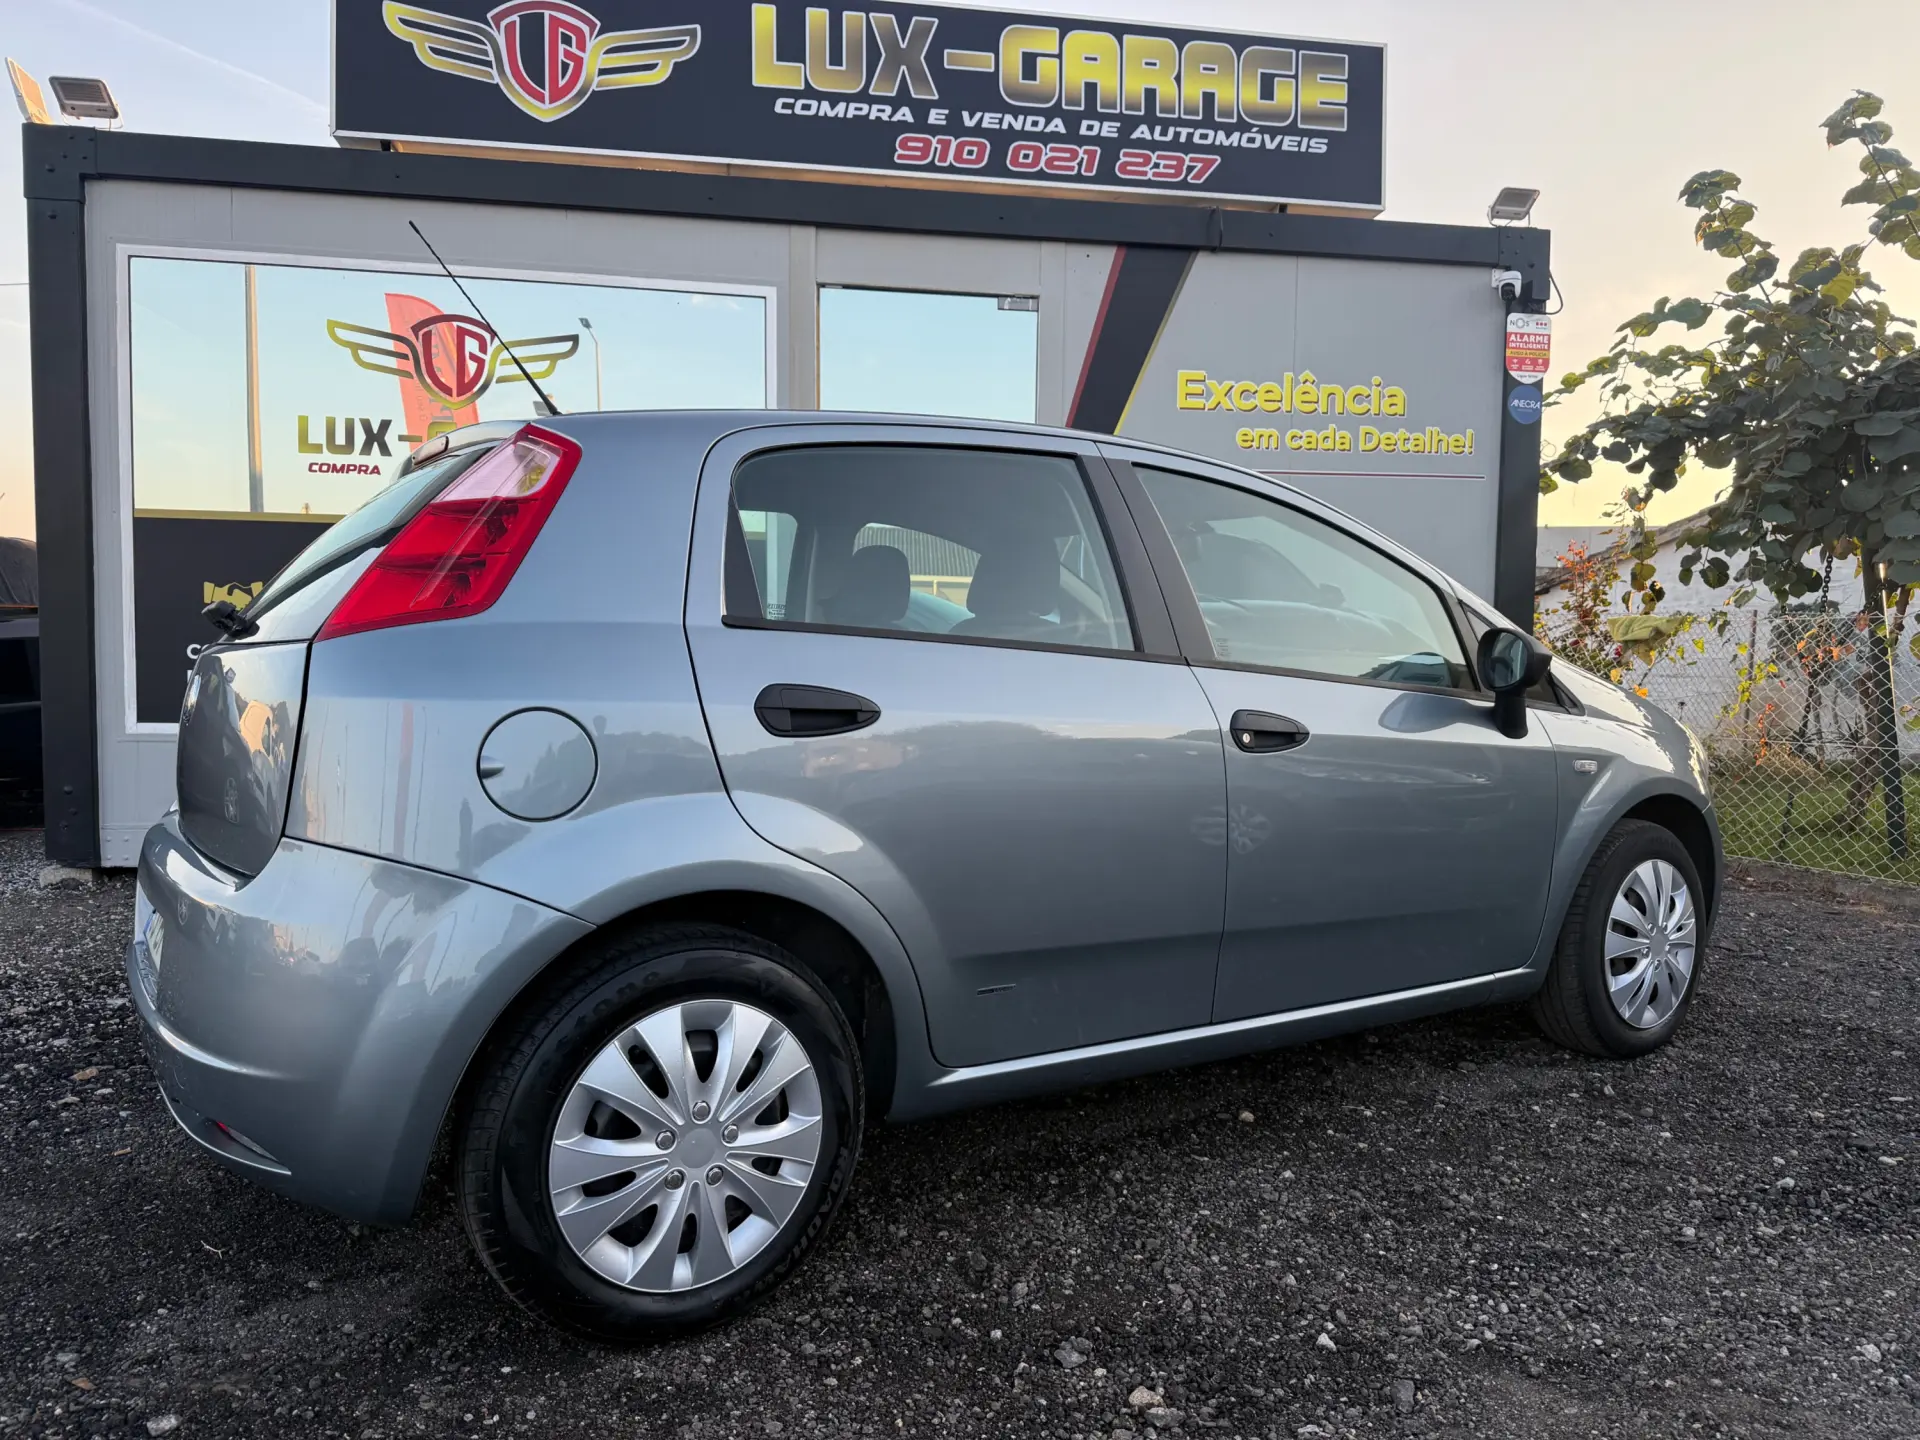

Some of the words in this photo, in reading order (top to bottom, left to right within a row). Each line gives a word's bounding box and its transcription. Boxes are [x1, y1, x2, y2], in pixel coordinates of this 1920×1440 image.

[752, 3, 1348, 131] LUX-GARAGE
[774, 98, 915, 123] COMPRA
[927, 108, 950, 126] E
[962, 111, 1067, 134] VENDA
[1079, 119, 1121, 138] DE
[1130, 124, 1328, 154] AUTOMÓVEIS
[894, 133, 990, 168] 910
[1006, 140, 1101, 176] 021
[1115, 148, 1221, 184] 237
[1509, 334, 1549, 343] ALARME
[1509, 342, 1548, 350] INTELIGENTE
[1176, 369, 1406, 417] Excelência
[1511, 398, 1540, 409] ANECRA
[1236, 427, 1279, 450] em
[1286, 424, 1352, 452] cada
[1359, 426, 1475, 456] Detalhe!
[308, 462, 382, 476] COMPRA
